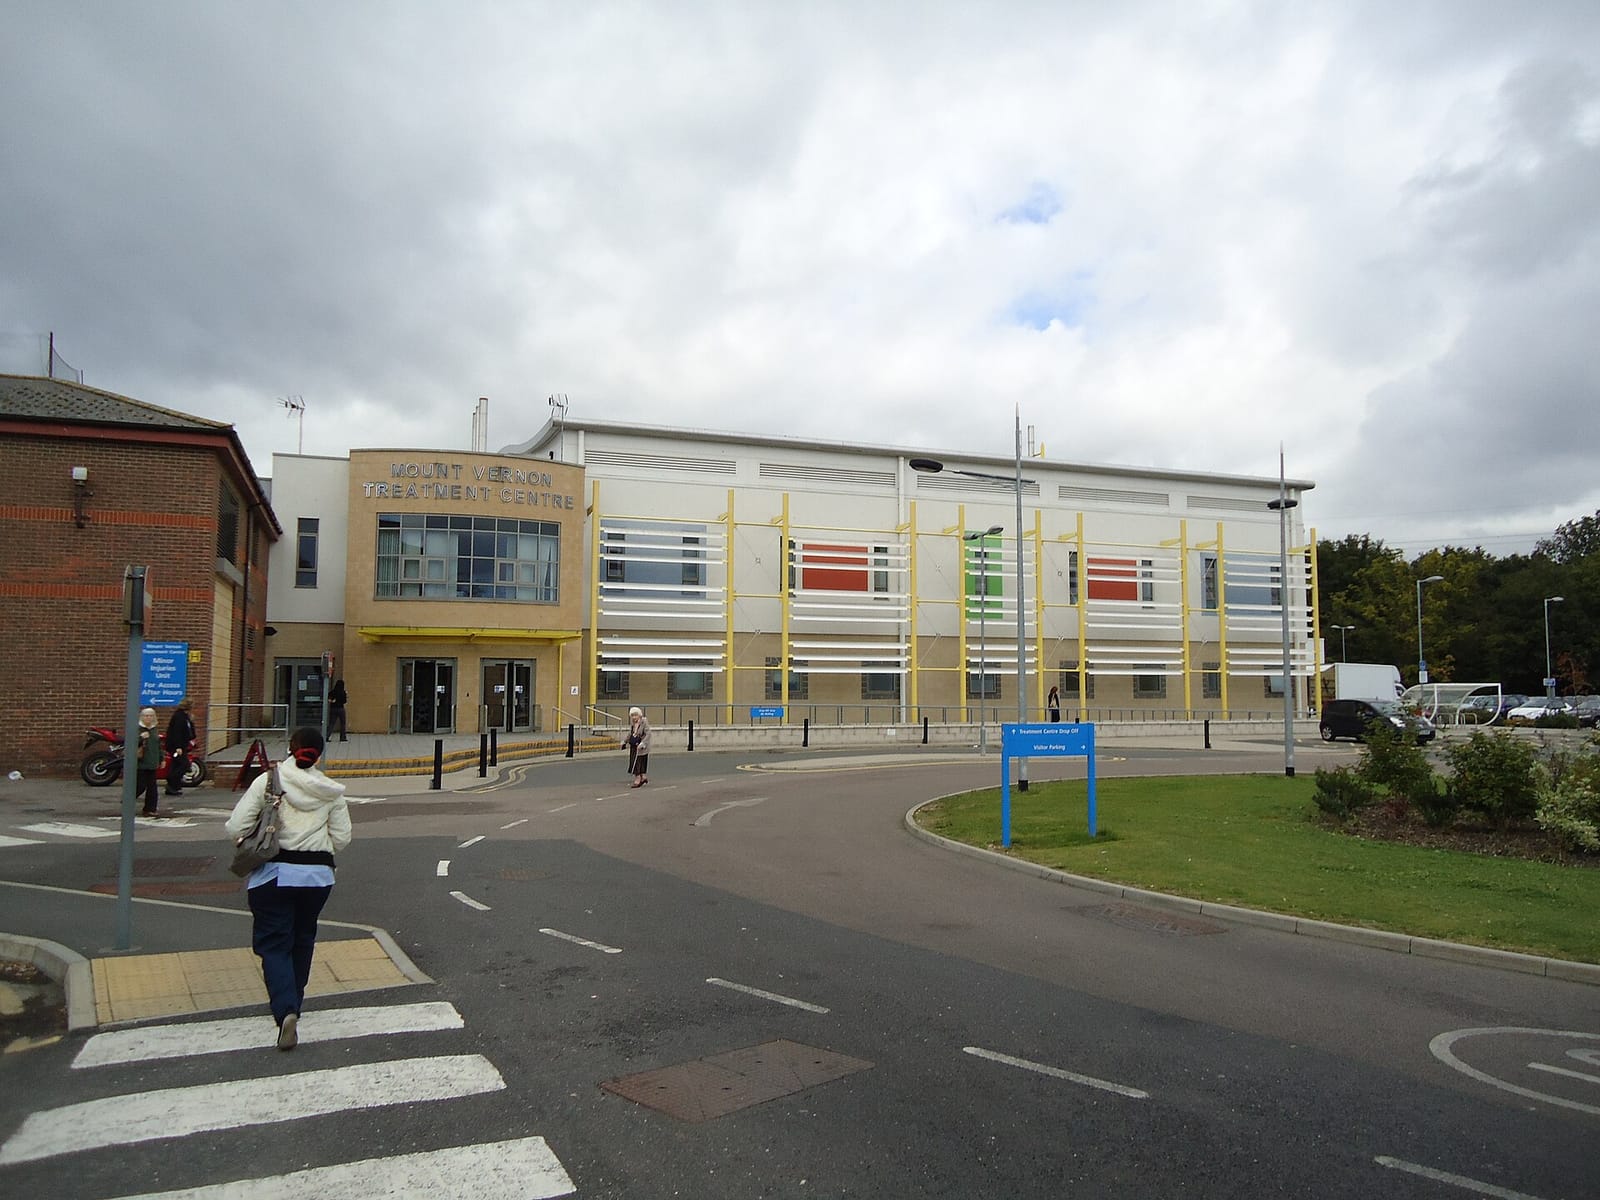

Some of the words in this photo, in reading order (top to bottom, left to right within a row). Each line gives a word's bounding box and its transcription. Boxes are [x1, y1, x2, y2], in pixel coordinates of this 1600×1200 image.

[391, 463, 463, 480] MOUNT
[473, 465, 552, 487] VERNON
[363, 483, 491, 500] TREATMENT
[501, 488, 574, 510] CENTRE
[1049, 744, 1066, 752] Parking
